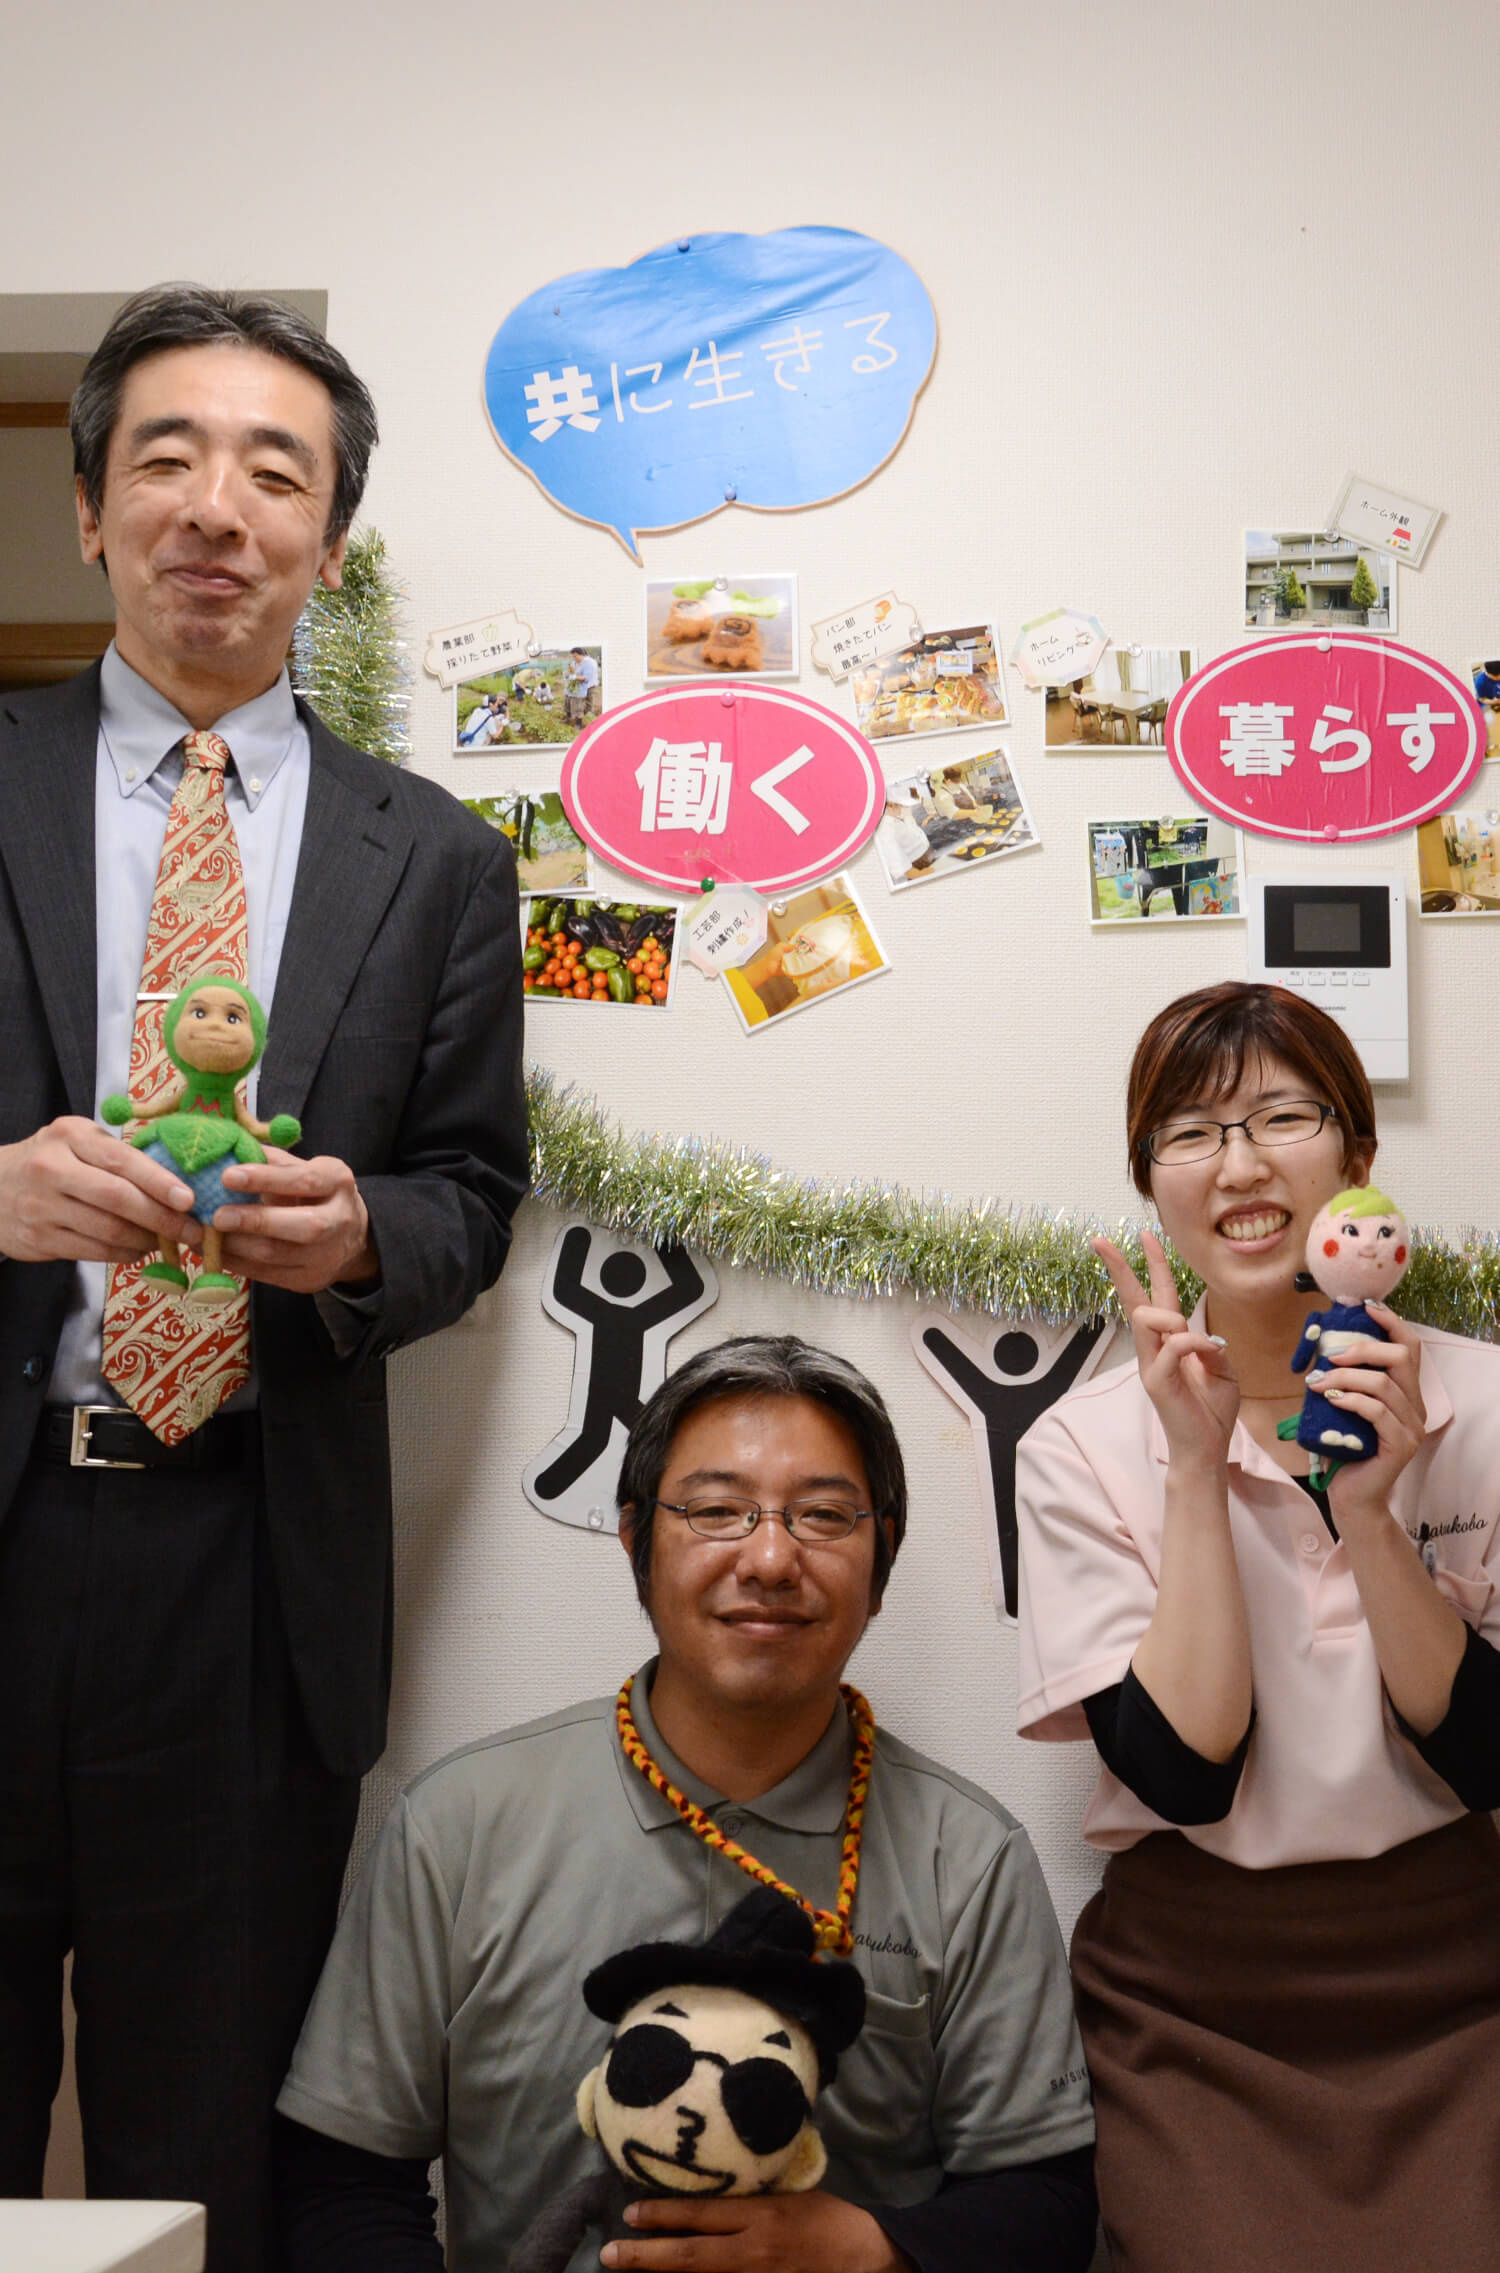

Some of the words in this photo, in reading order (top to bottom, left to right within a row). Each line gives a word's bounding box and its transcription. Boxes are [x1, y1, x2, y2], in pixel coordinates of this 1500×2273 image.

[524, 312, 898, 442] 共に生きる
[1030, 635, 1059, 652] ホーム
[1037, 645, 1074, 667] リビング
[1218, 702, 1456, 776] 暮らす
[634, 737, 815, 836] 働く
